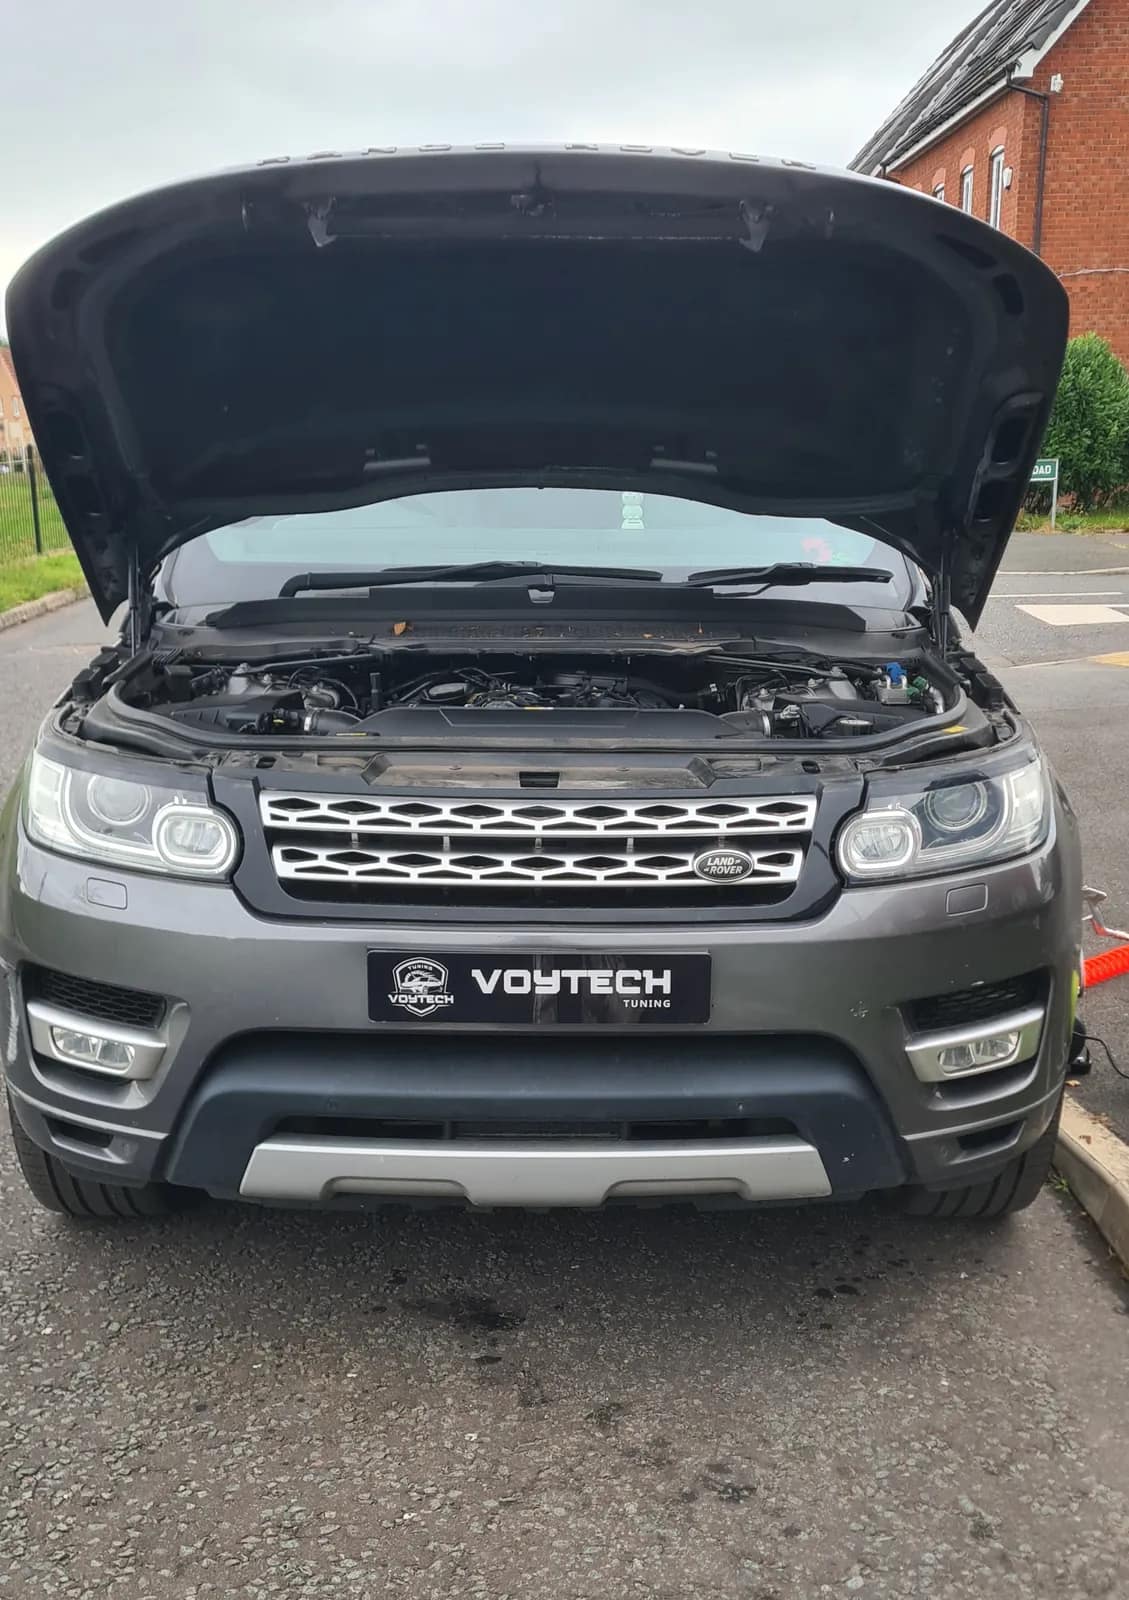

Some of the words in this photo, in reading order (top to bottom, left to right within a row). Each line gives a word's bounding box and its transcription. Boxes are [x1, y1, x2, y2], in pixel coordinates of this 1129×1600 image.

[1032, 464, 1052, 475] OAD
[706, 857, 735, 866] LAND
[709, 865, 743, 875] ROVER
[471, 969, 672, 995] VOYTECH
[387, 994, 455, 1004] VOYTECH
[623, 999, 672, 1009] TUNING
